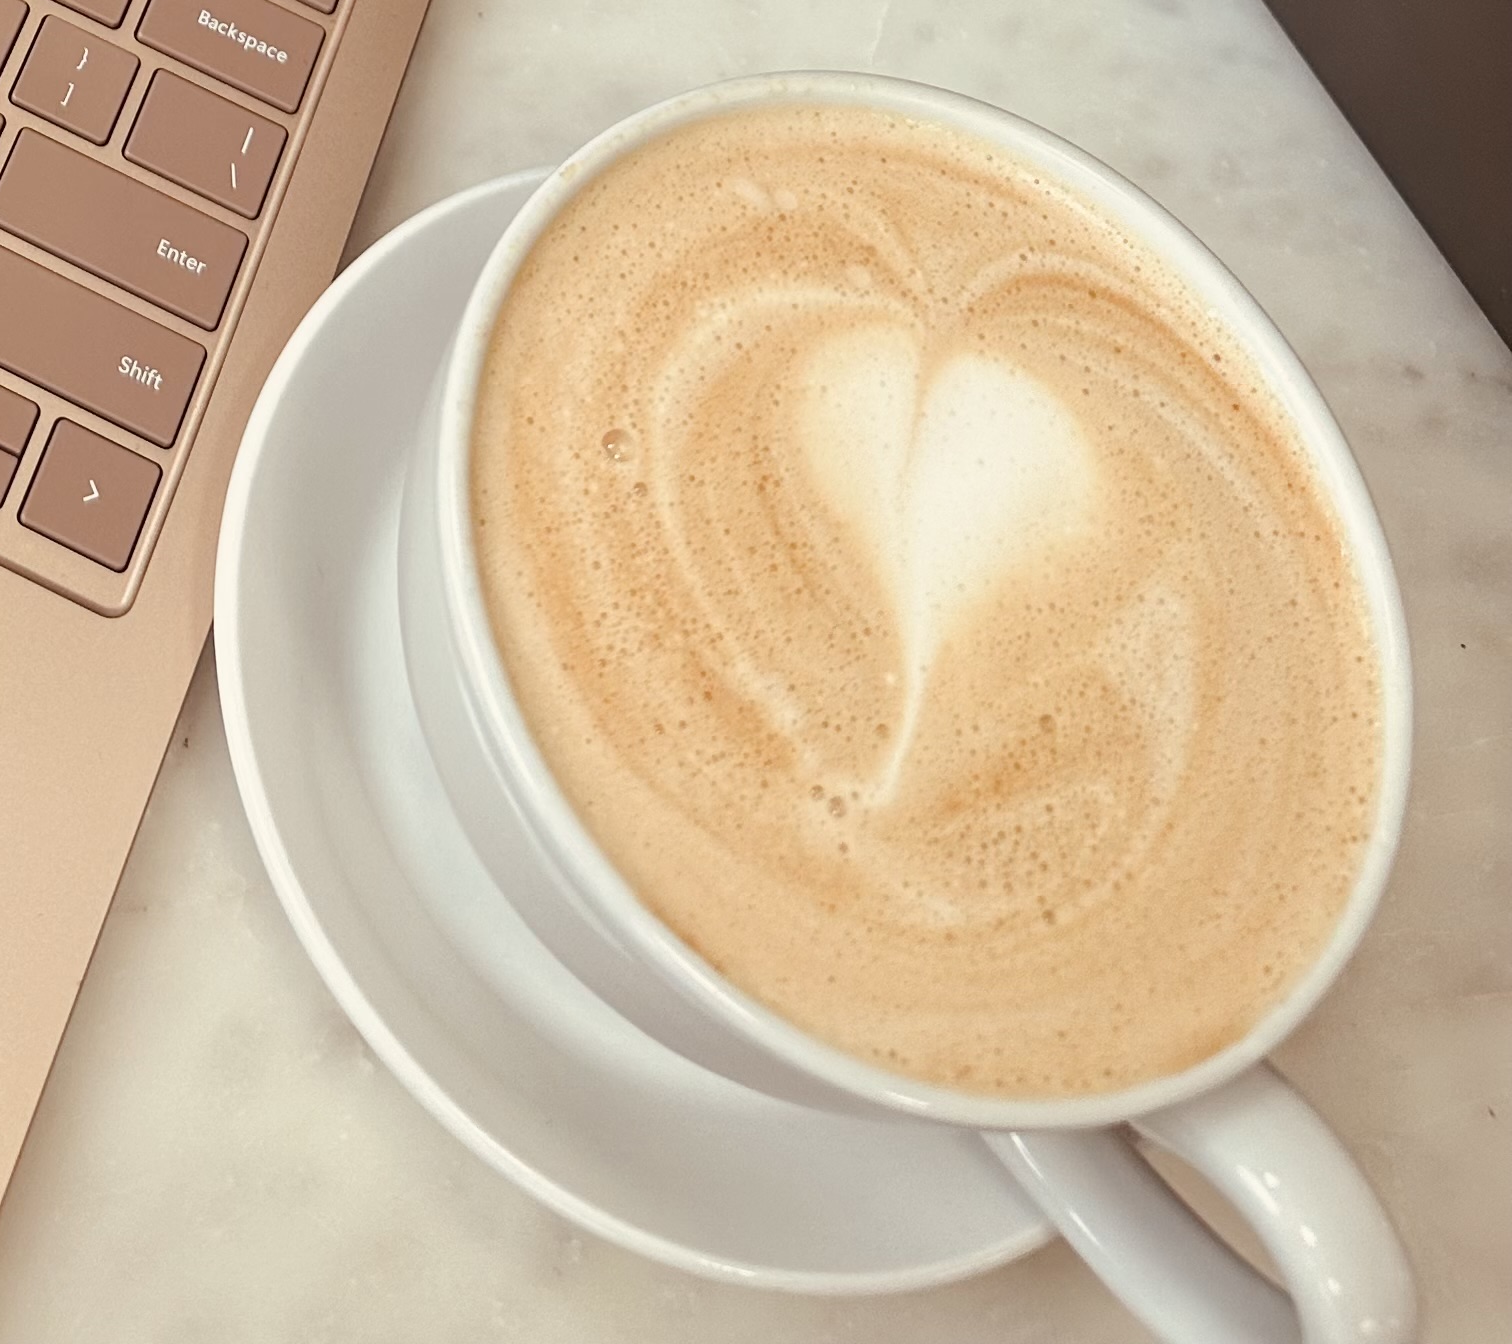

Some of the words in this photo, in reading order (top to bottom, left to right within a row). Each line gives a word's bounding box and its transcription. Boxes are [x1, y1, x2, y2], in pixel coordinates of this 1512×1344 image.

[197, 9, 288, 63] Backspace
[156, 238, 207, 275] Enter
[118, 356, 164, 390] Shift
